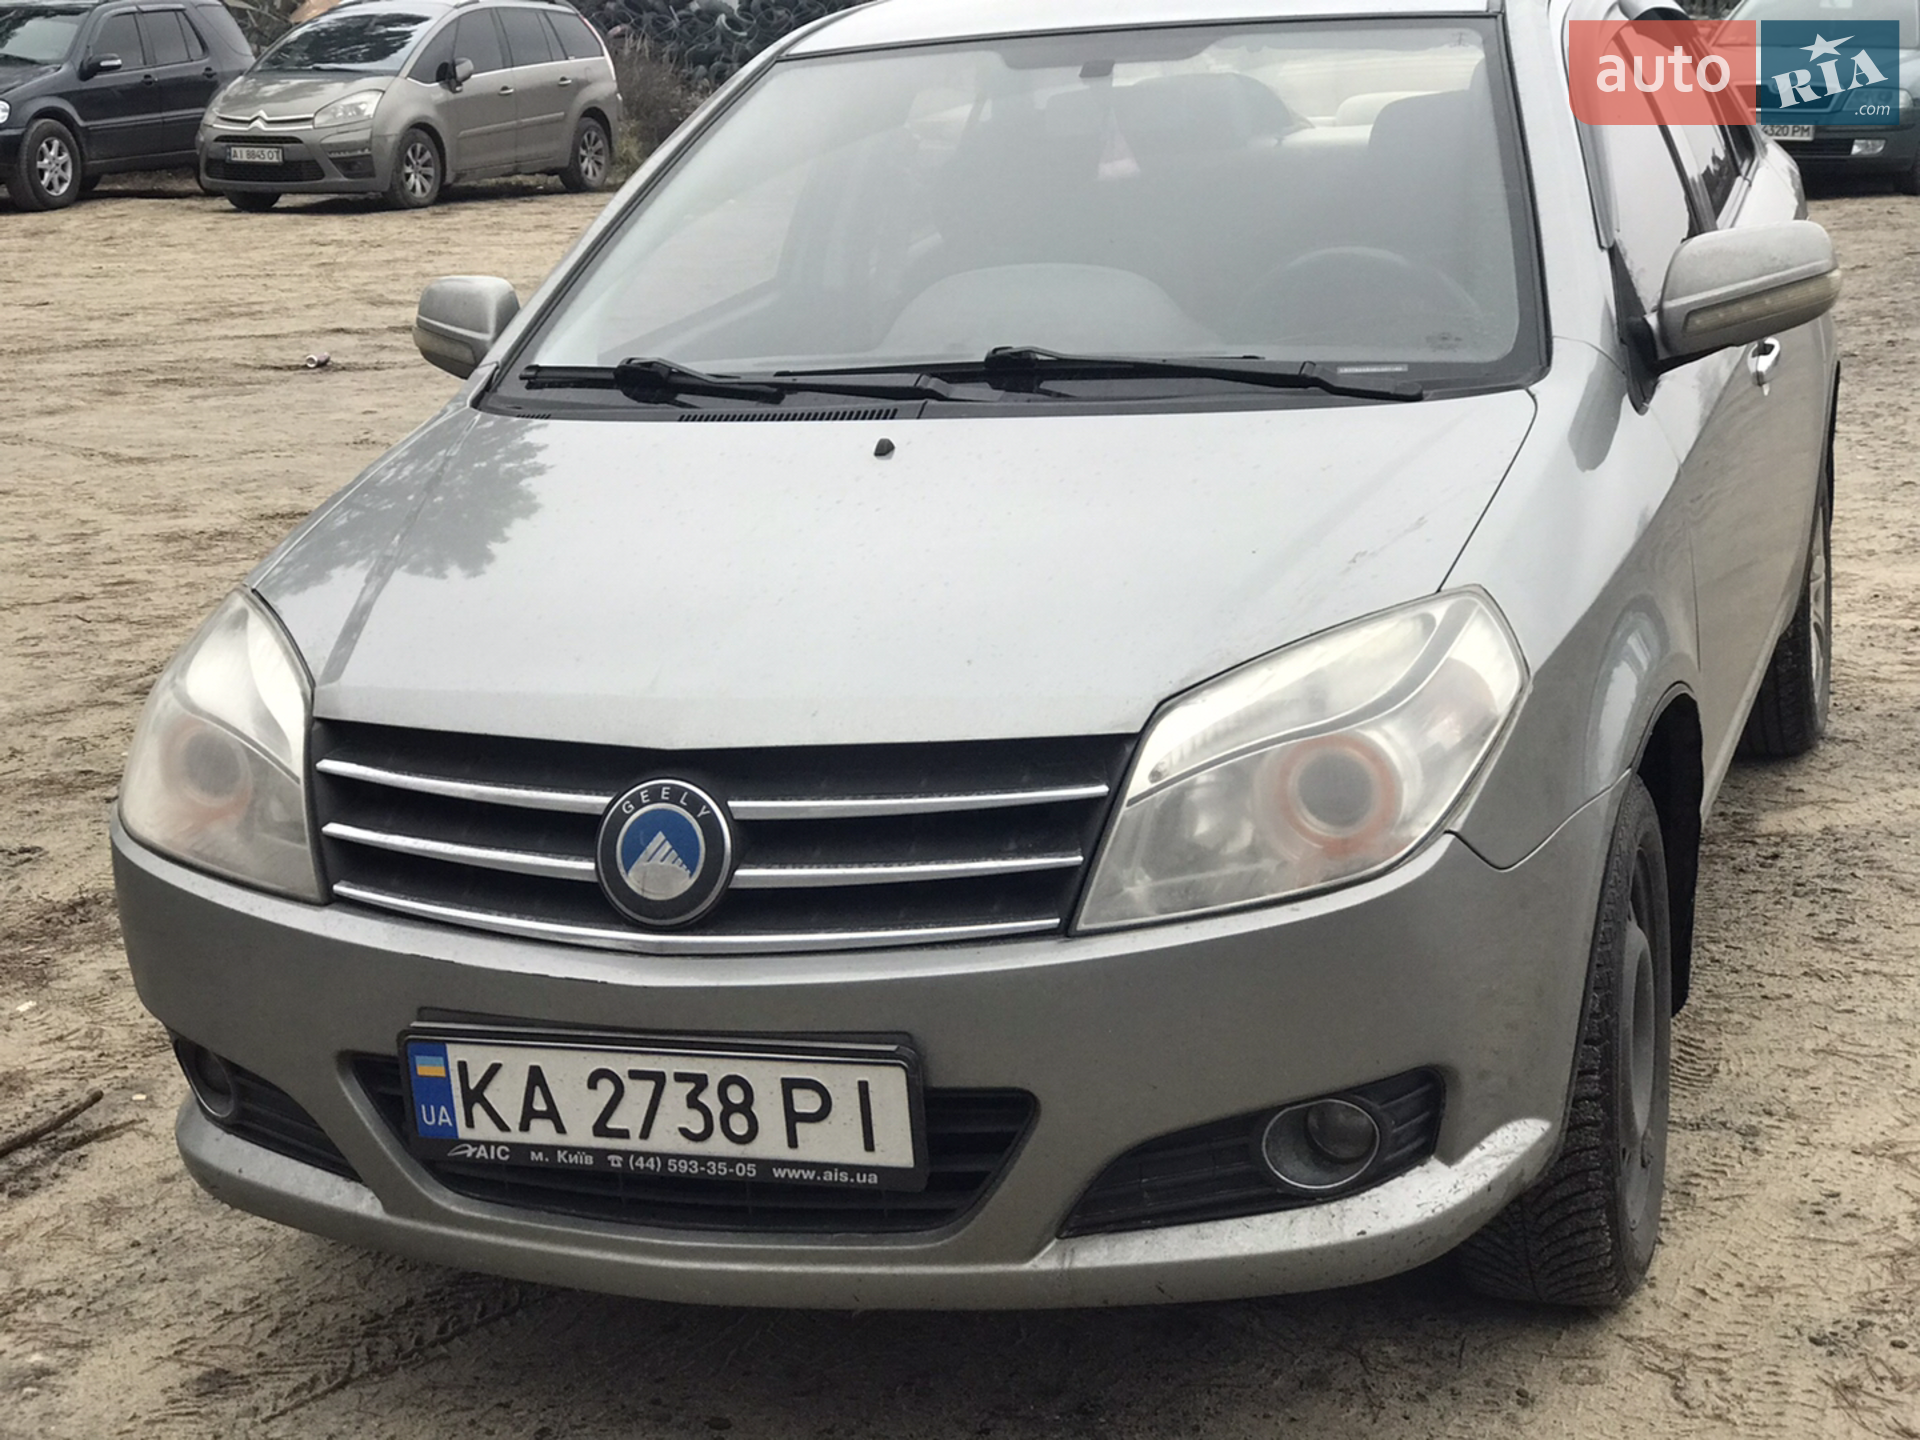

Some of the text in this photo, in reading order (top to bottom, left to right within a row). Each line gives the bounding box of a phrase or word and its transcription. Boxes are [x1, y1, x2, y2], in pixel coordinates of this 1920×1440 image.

[621, 787, 711, 818] GEELY
[422, 1103, 453, 1127] UA
[456, 1060, 876, 1153] KA 2738 PI
[557, 1149, 594, 1165] Київ
[628, 1154, 661, 1172] (44)
[667, 1158, 757, 1177] 593-35-05
[772, 1166, 878, 1184] www.ais.ua
